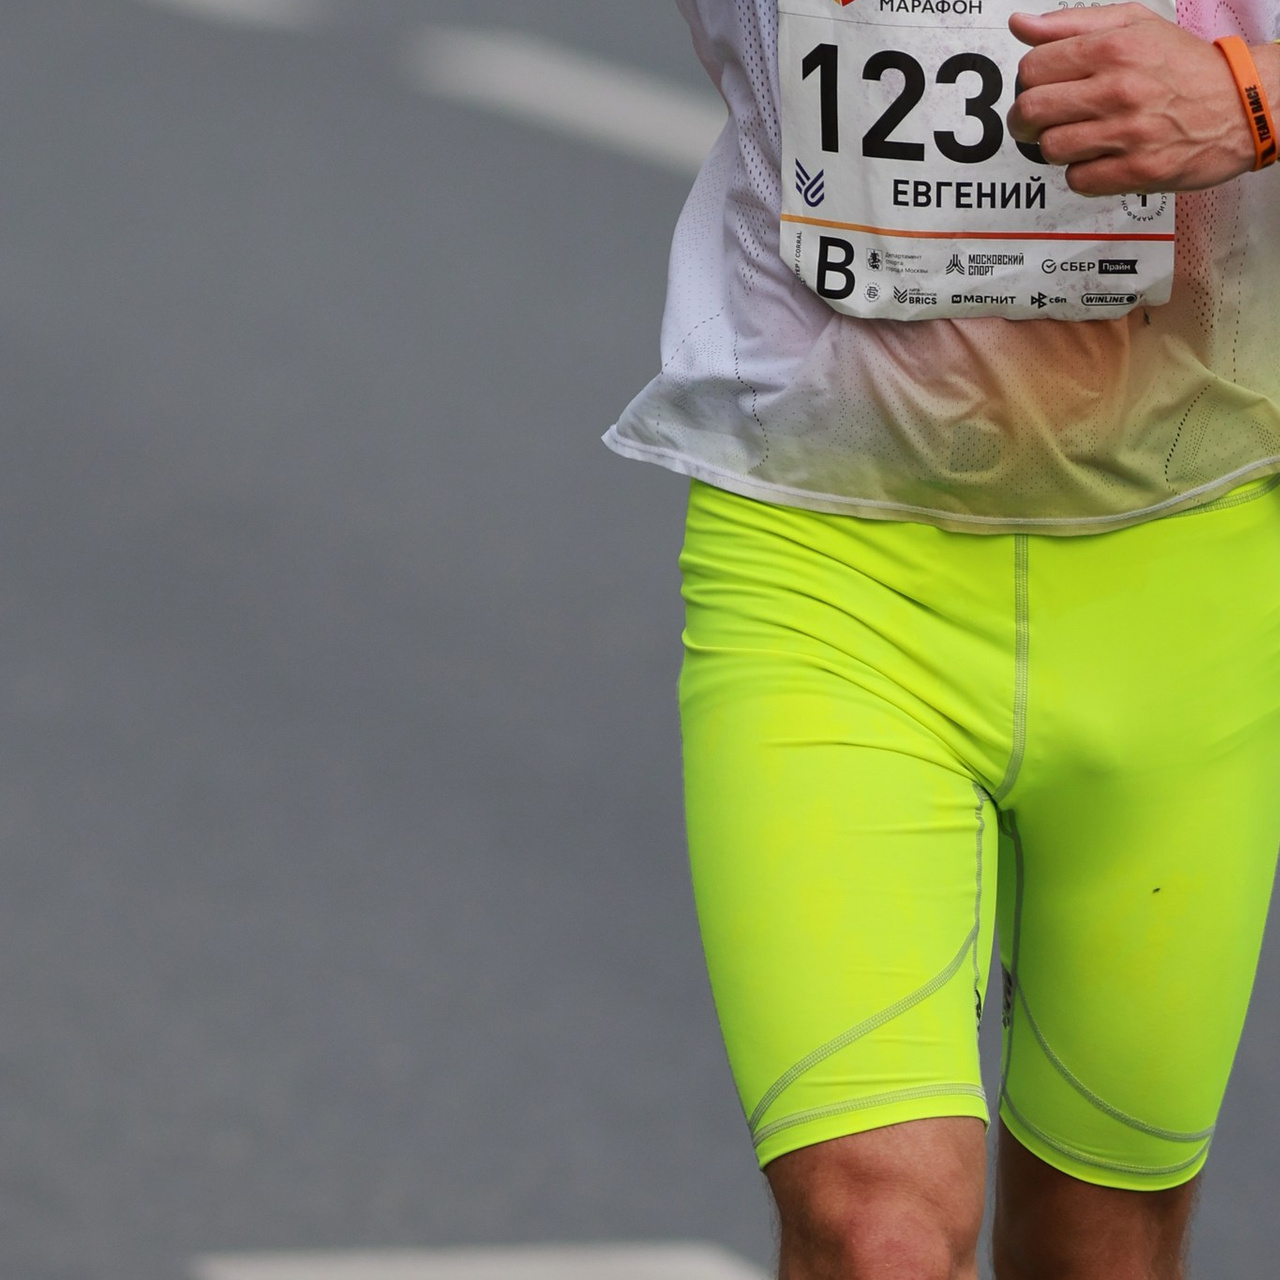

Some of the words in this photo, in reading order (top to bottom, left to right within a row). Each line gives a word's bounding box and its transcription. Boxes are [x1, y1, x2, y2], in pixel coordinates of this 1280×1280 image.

[879, 0, 983, 15] МАРАФОН
[801, 43, 1050, 165] 123
[1245, 84, 1264, 114] RACE
[1254, 114, 1271, 143] TEAM
[892, 176, 1047, 209] ЕВГЕНИЙ
[794, 231, 803, 258] CORRAL
[968, 252, 1024, 266] МОСКОВСКИЙ
[1060, 261, 1096, 272] СБЕР
[1102, 262, 1131, 272] Прайм
[968, 266, 995, 276] СПОРТ
[909, 297, 937, 305] BRICS
